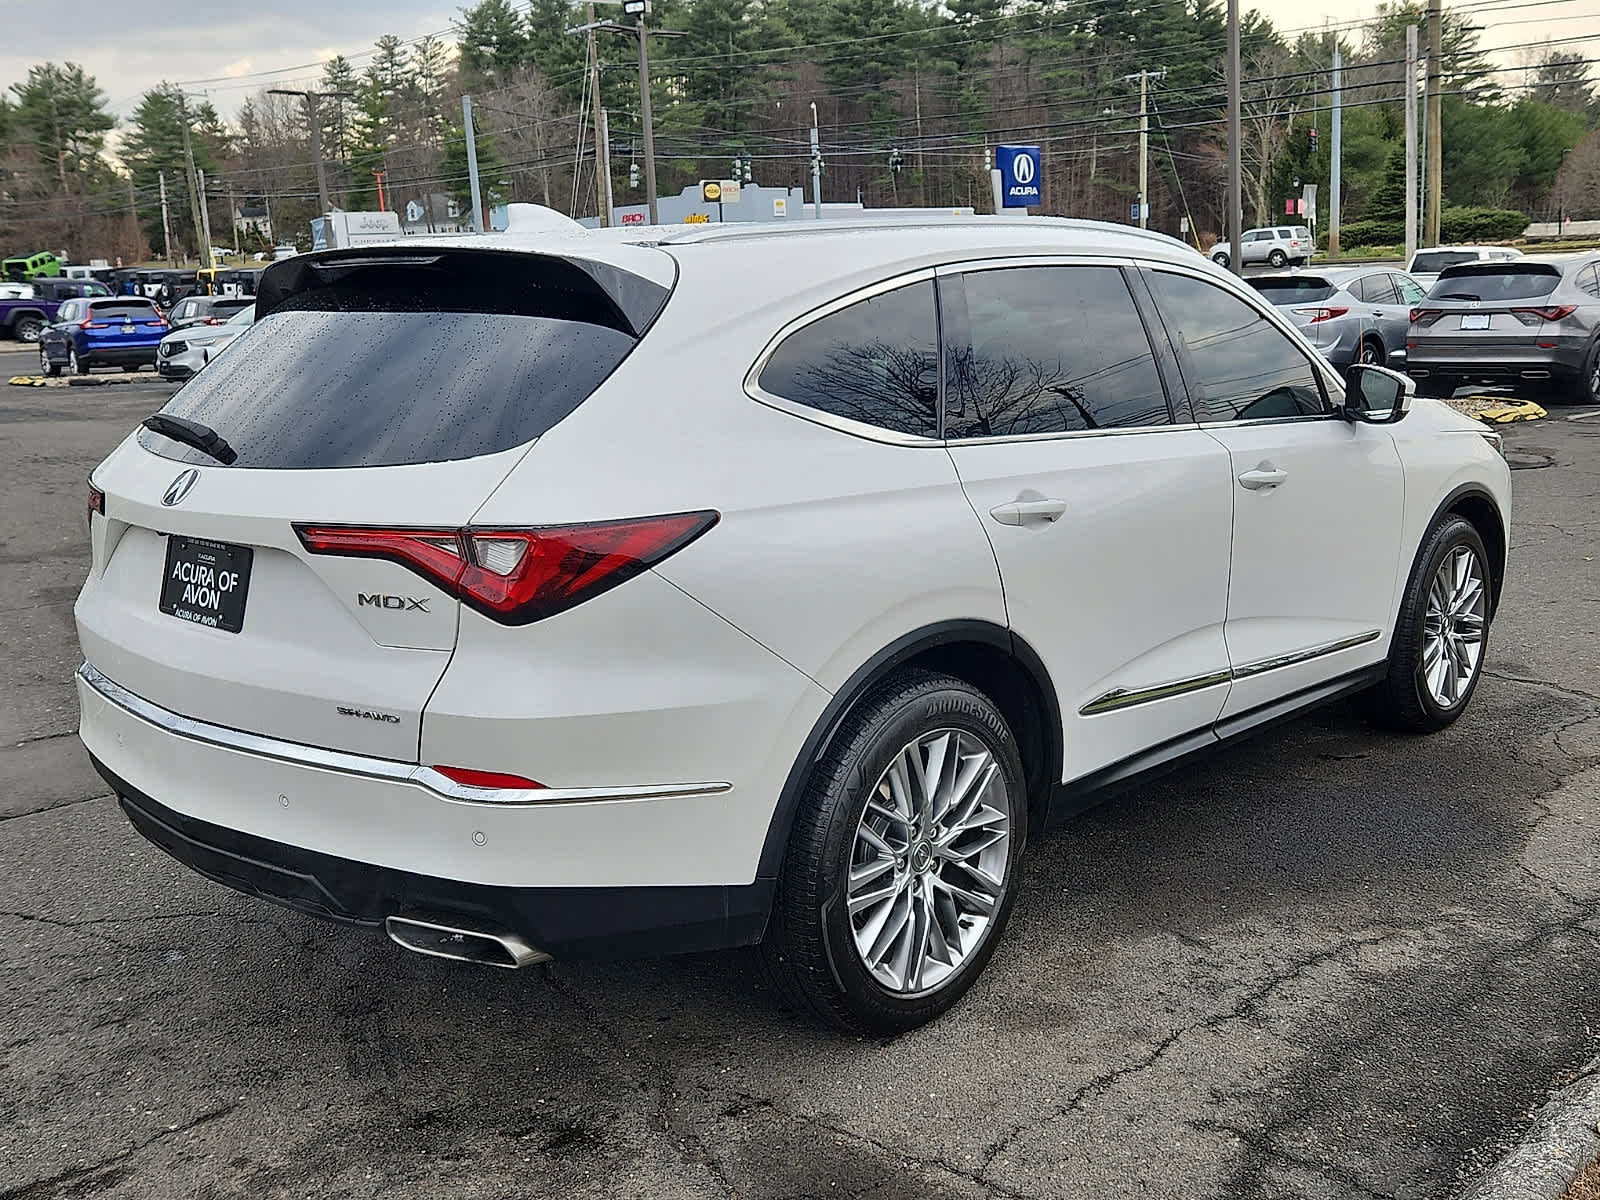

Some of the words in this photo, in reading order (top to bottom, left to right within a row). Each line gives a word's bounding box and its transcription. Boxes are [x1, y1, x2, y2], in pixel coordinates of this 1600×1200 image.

[1009, 186, 1038, 196] ACURA
[172, 561, 215, 589] ACURA
[218, 570, 239, 593] OF
[182, 584, 220, 610] AVON
[357, 591, 432, 614] MDX
[175, 608, 192, 620] ACURA
[192, 613, 202, 623] OF
[201, 616, 217, 627] AVON
[925, 698, 1010, 744] BRIDGESTONE
